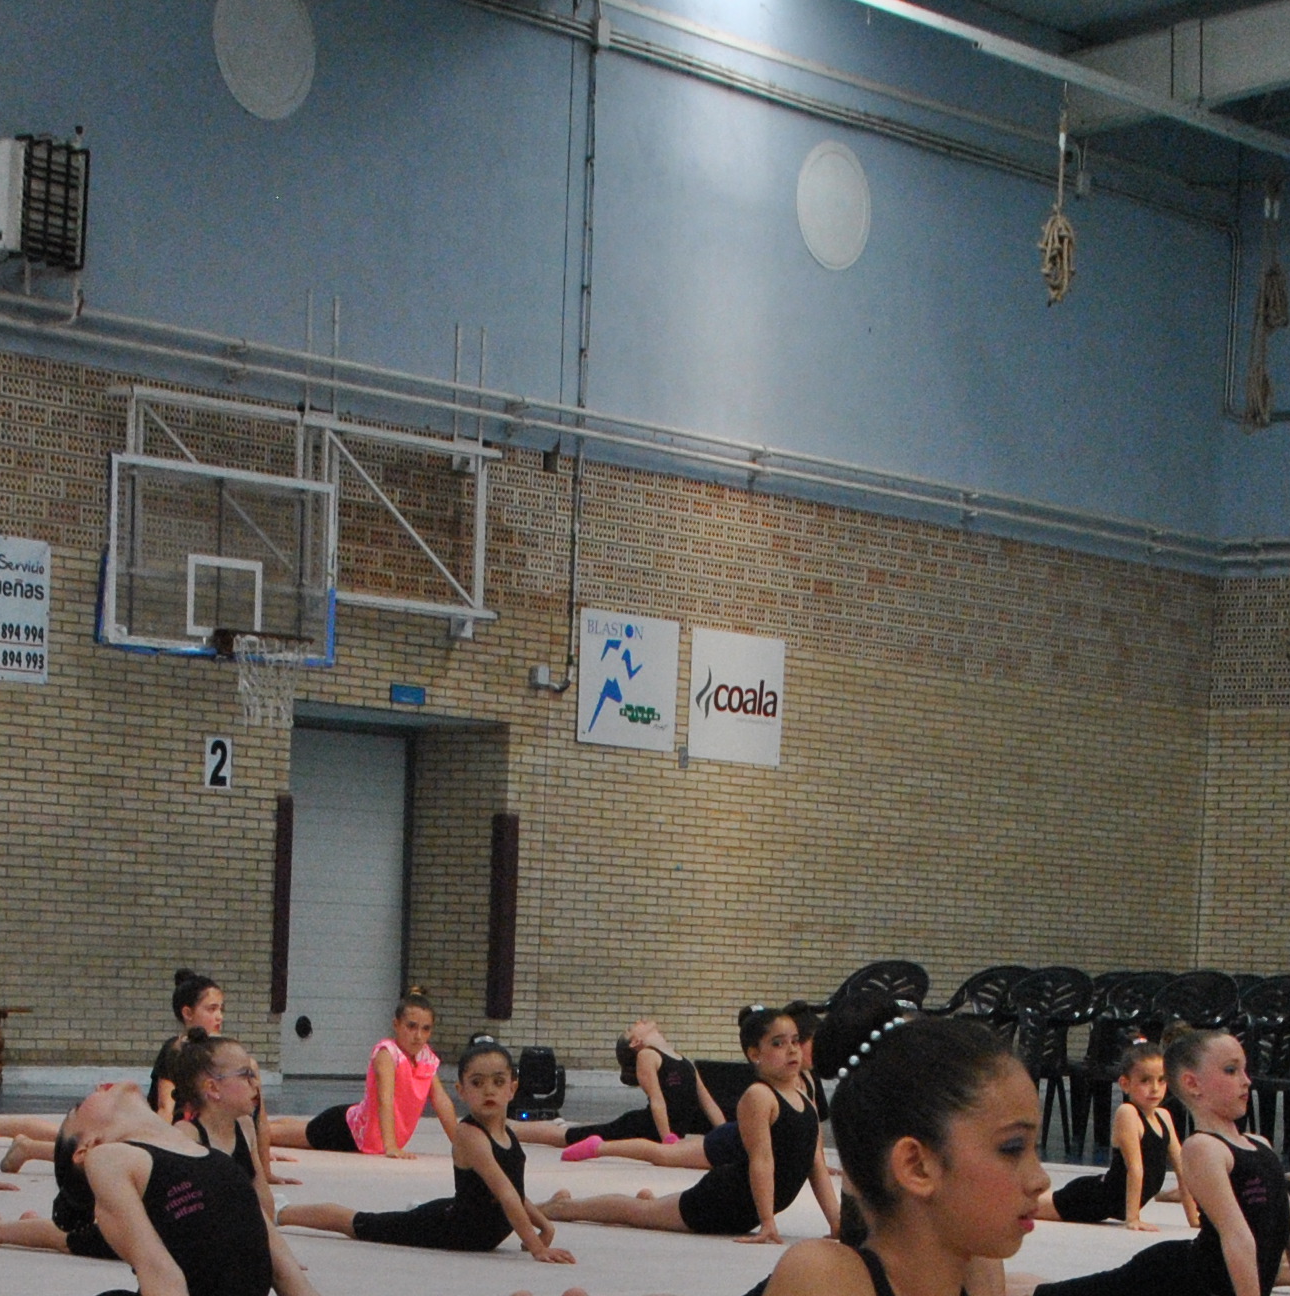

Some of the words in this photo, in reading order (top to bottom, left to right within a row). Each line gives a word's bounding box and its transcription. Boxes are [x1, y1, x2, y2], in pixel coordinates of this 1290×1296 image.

[1, 622, 21, 641] 894
[24, 624, 45, 643] 994
[2, 649, 22, 668] 894
[25, 651, 45, 671] 993
[713, 679, 779, 718] coala
[210, 739, 229, 788] 2
